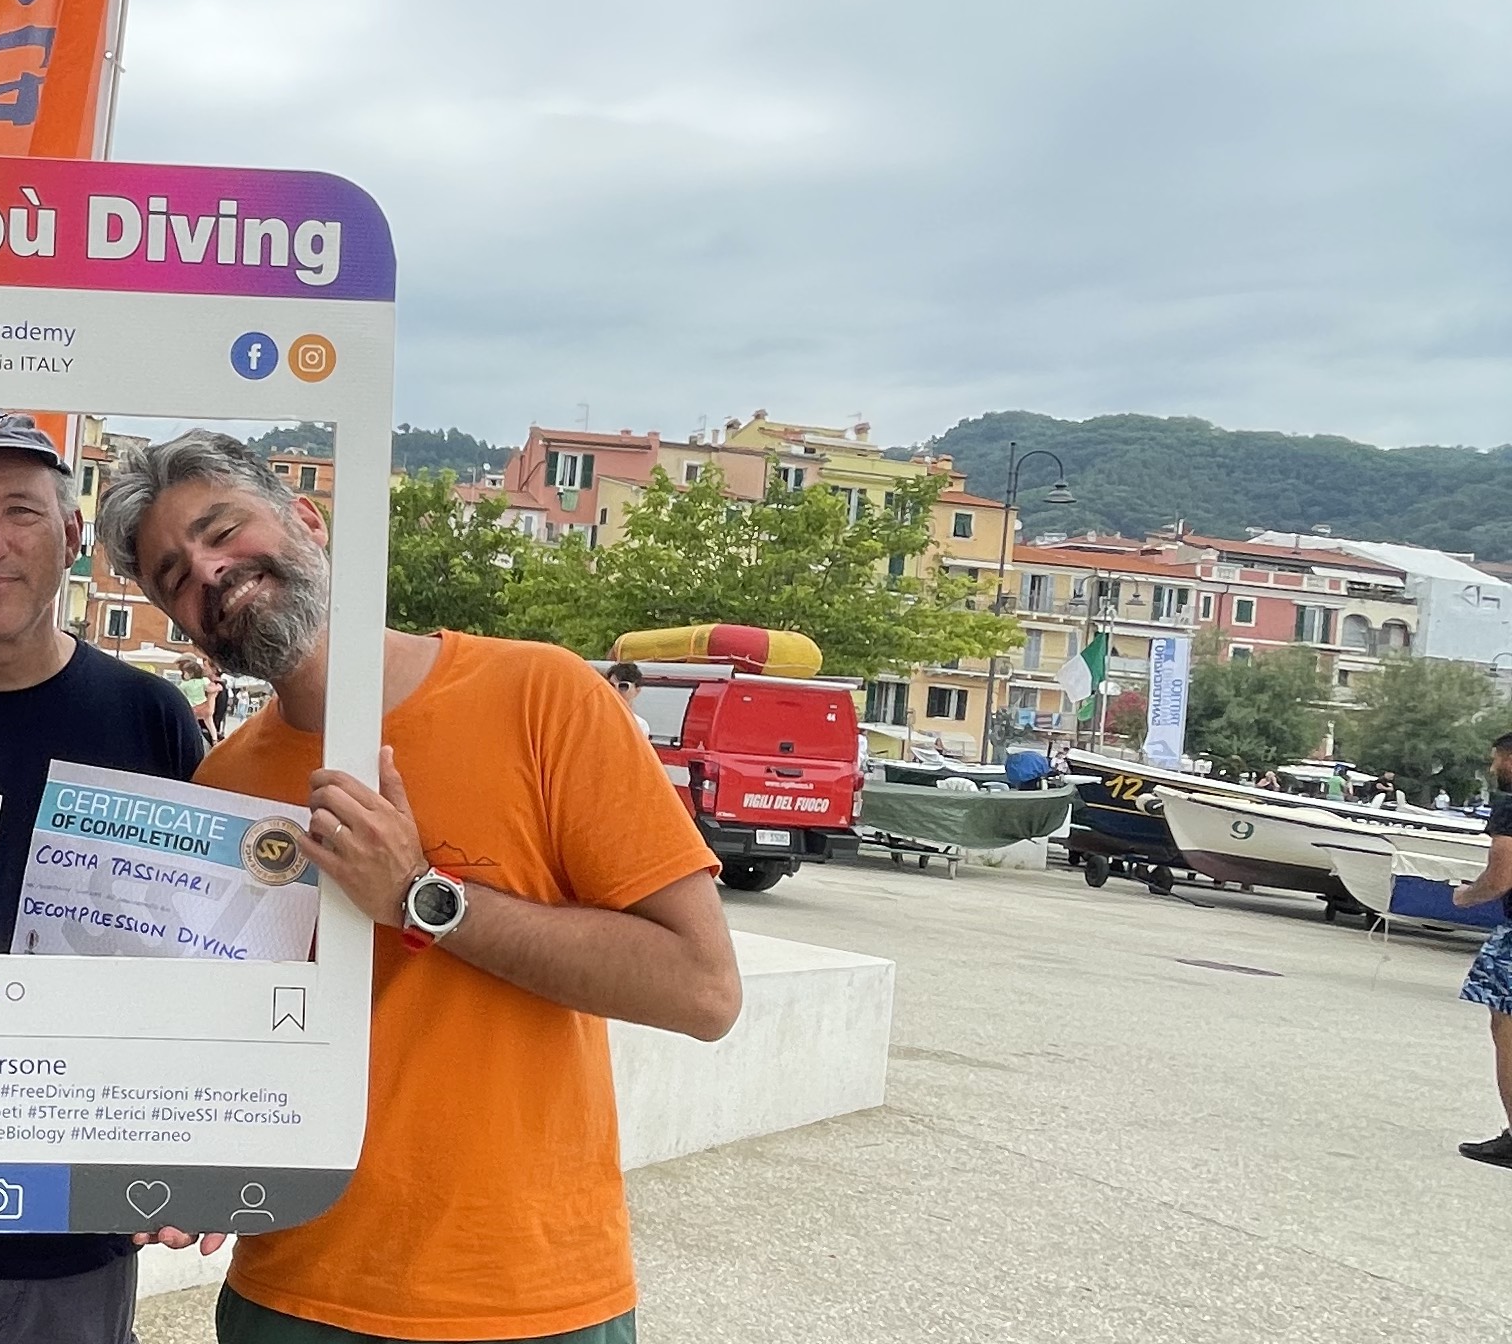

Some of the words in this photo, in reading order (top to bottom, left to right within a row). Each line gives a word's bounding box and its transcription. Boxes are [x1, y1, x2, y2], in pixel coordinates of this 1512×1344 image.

[86, 195, 341, 286] Diving
[20, 356, 74, 373] ITALY
[1105, 774, 1143, 801] 12
[56, 788, 228, 841] CERTIFICATE
[743, 793, 773, 810] VIGILI
[773, 795, 793, 810] DEL
[794, 796, 830, 813] FUOCO
[51, 813, 77, 830] OF
[80, 818, 210, 856] COMPLETION
[1229, 820, 1255, 840] 9
[111, 858, 211, 895] TASSINARI
[23, 897, 166, 938] DECOMPRESSION
[1, 1084, 96, 1102] #FreeDiving
[102, 1085, 189, 1101] #Escursioni
[194, 1087, 288, 1106] #Snorkeling
[28, 1105, 90, 1120] #5Terre
[95, 1106, 146, 1121] #Lerici
[151, 1107, 218, 1122] #DiveSSI
[224, 1109, 301, 1125] #CorsiSub
[71, 1127, 191, 1143] #Mediterraneo
